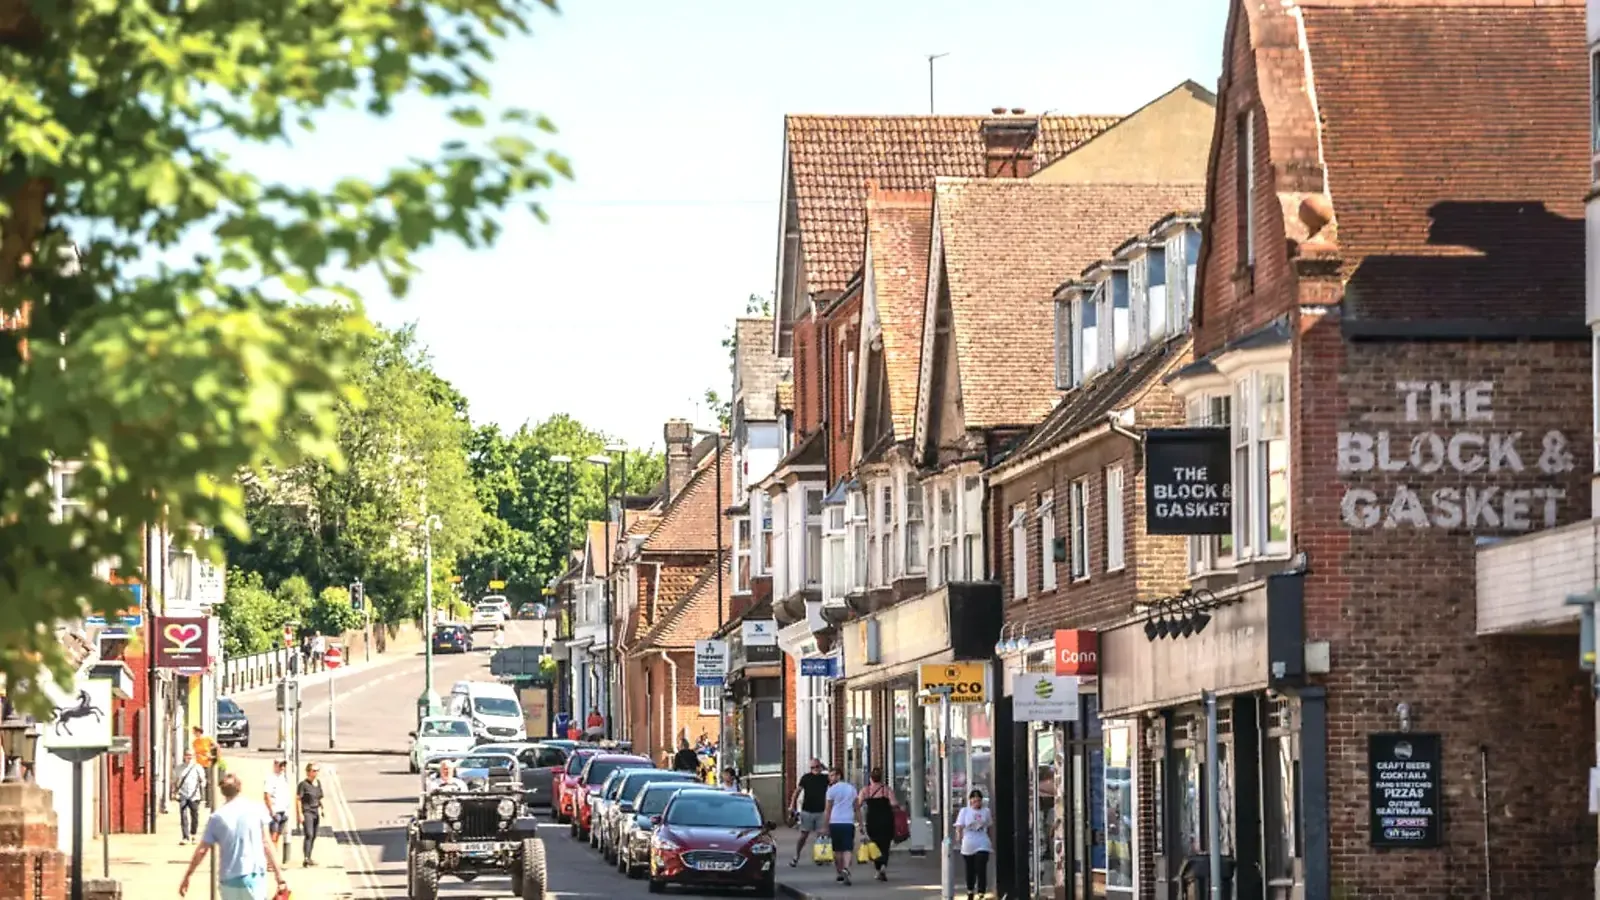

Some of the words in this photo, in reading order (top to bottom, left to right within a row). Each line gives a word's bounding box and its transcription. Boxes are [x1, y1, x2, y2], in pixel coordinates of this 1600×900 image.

[1397, 380, 1494, 422] THE
[1337, 431, 1525, 473] BLOCK
[1539, 430, 1576, 473] &
[1173, 466, 1208, 481] THE
[1153, 484, 1218, 499] BLOCK
[1156, 502, 1230, 517] GASKET
[1341, 485, 1567, 530] GASKET
[1061, 649, 1097, 664] Conn
[924, 682, 982, 694] SCO
[924, 695, 983, 704] FURSHINGS
[1385, 789, 1424, 798] PIZZAS
